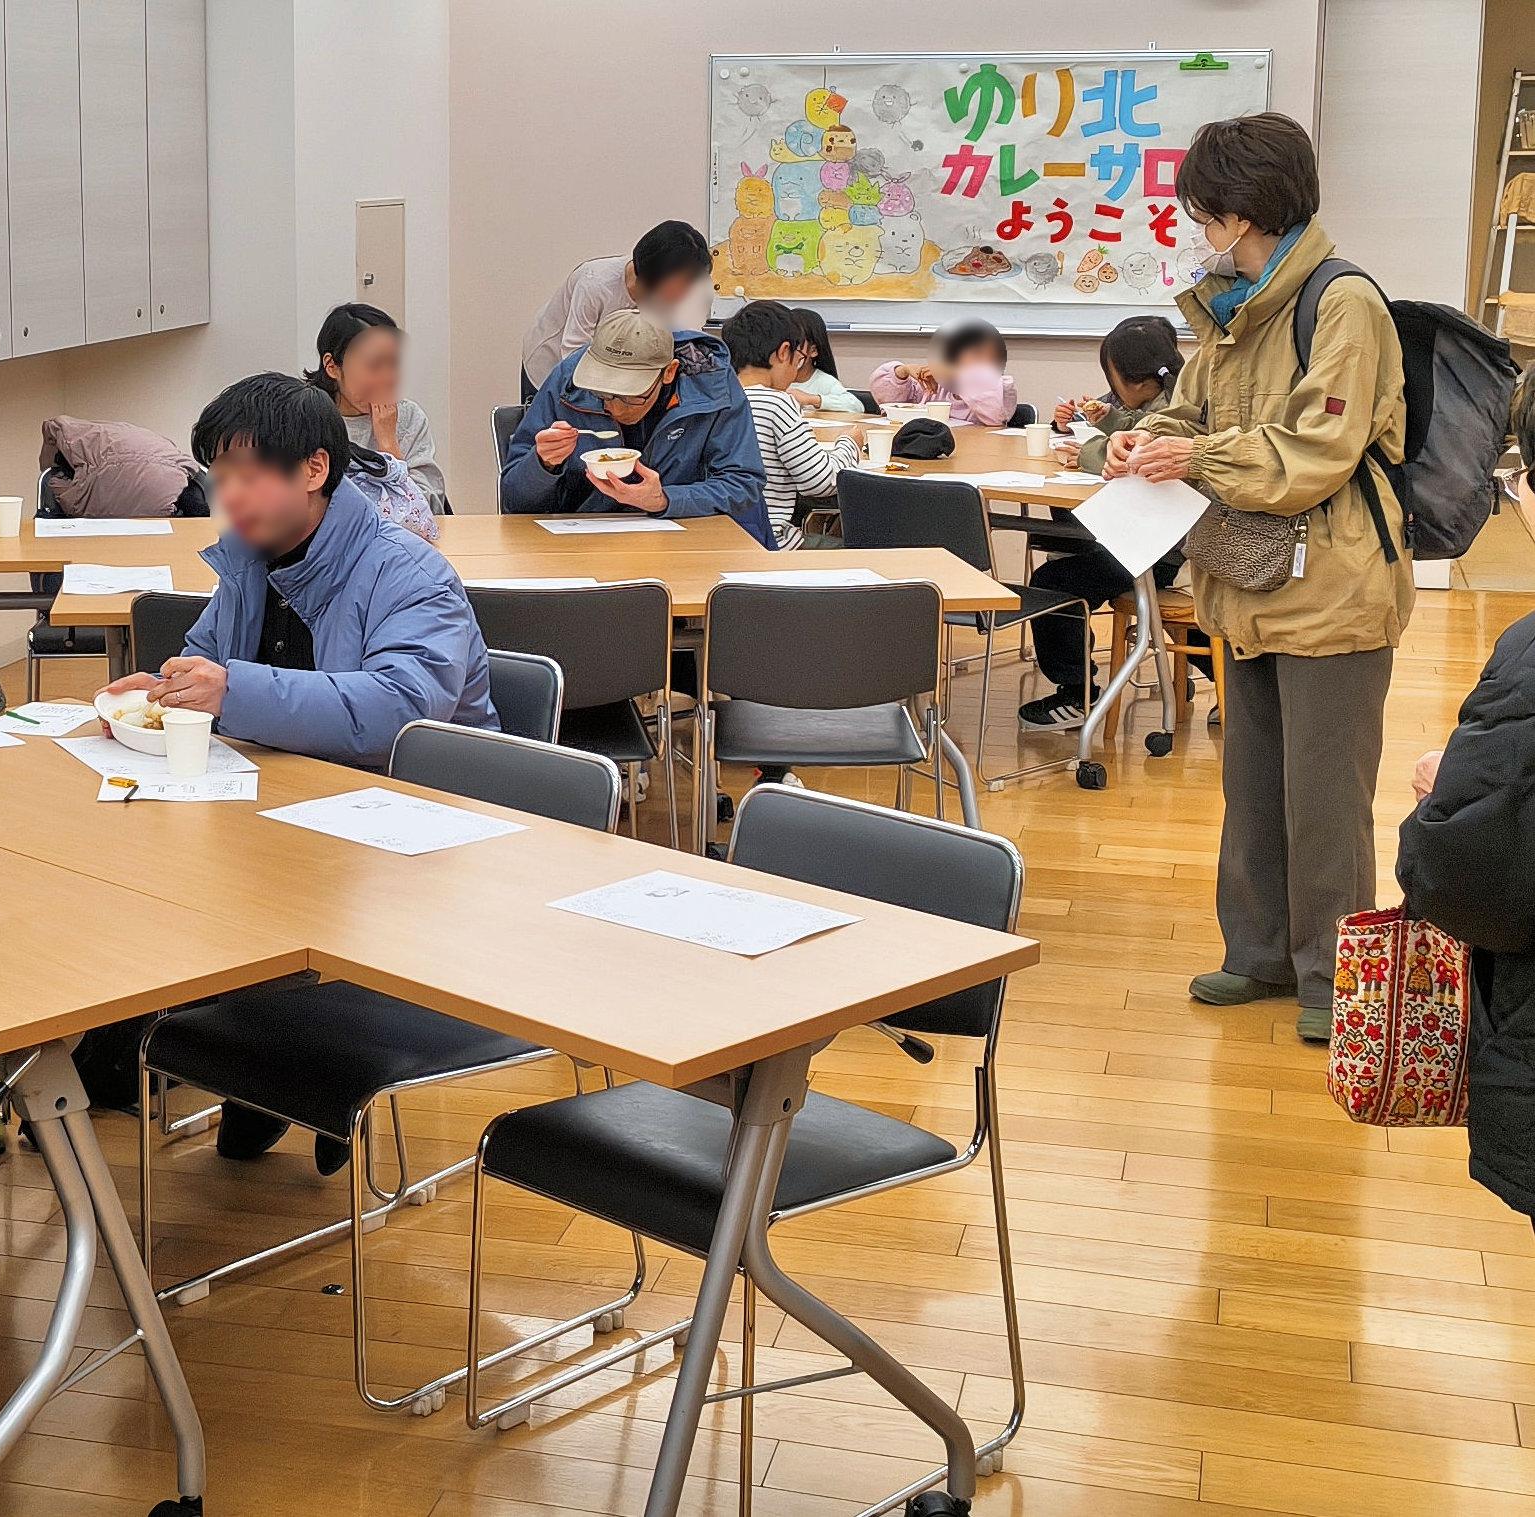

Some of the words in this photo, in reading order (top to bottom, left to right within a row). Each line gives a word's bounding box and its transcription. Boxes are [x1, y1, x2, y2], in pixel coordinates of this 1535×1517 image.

[944, 64, 1161, 142] ゆり北
[941, 143, 1184, 201] カレーサロ
[996, 197, 1178, 248] ようこそ
